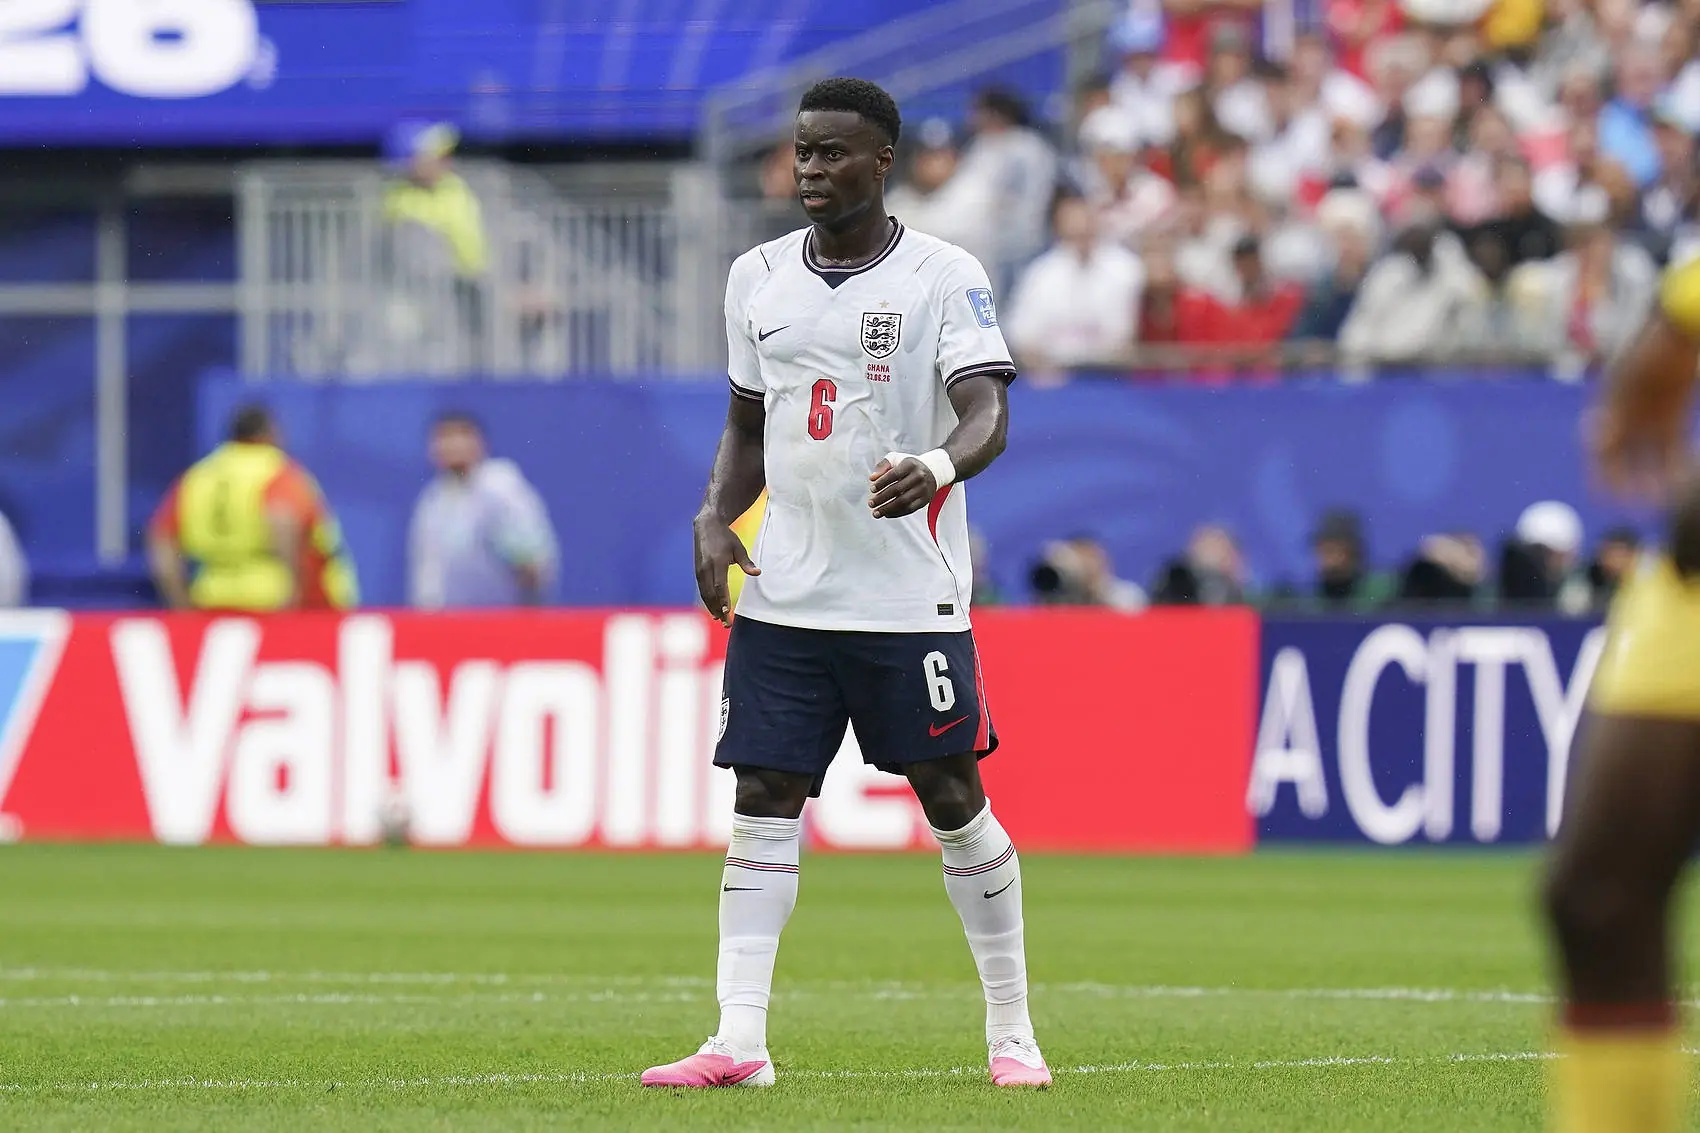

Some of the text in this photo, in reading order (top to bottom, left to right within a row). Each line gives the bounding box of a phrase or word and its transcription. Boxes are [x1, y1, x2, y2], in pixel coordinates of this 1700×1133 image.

[867, 363, 890, 373] GHANA
[807, 378, 837, 441] 6
[923, 650, 956, 712] 6
[1245, 635, 1607, 845] A CITY
